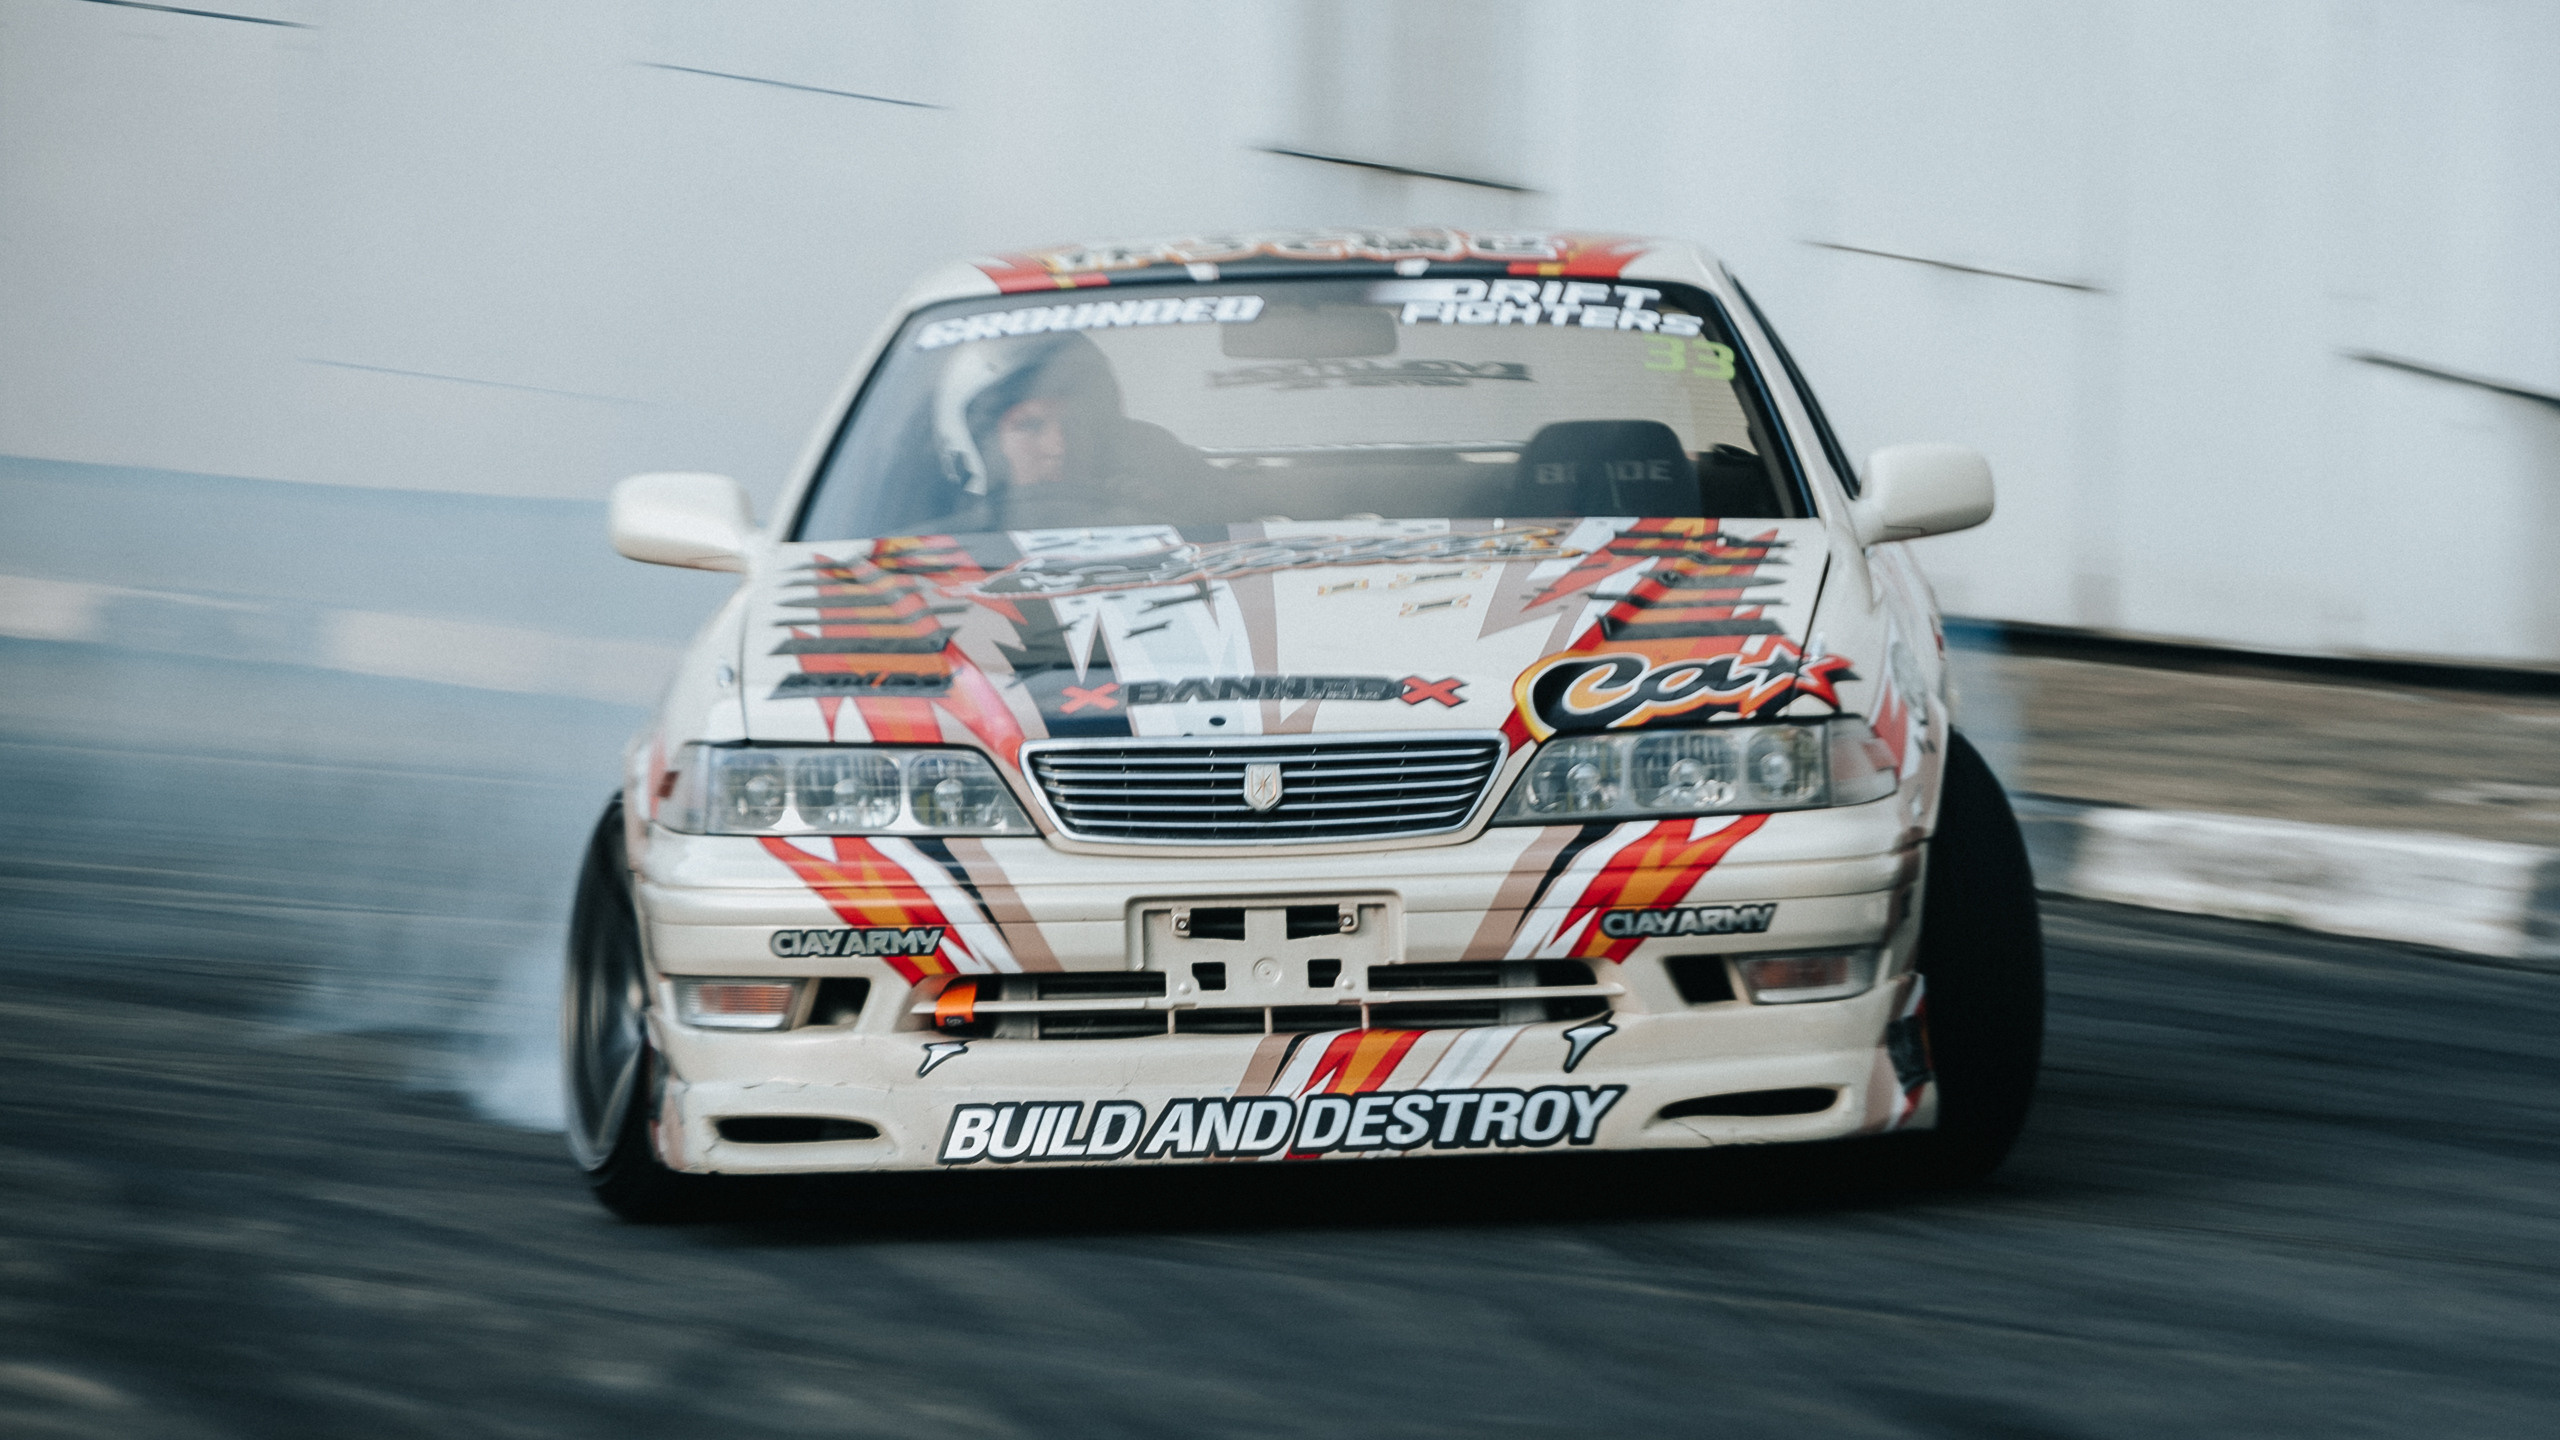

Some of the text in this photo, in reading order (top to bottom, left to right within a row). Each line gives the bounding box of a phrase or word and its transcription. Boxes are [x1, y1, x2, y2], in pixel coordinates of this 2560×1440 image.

[1449, 279, 1662, 311] DRIFT
[917, 295, 1265, 349] GROUNDED
[1401, 302, 1704, 337] FIGHTERS
[1644, 334, 1736, 381] 33
[1676, 903, 1777, 935] ARMY
[841, 927, 945, 956] ARMY
[940, 1086, 1626, 1163] BUILD AND DESTROY
